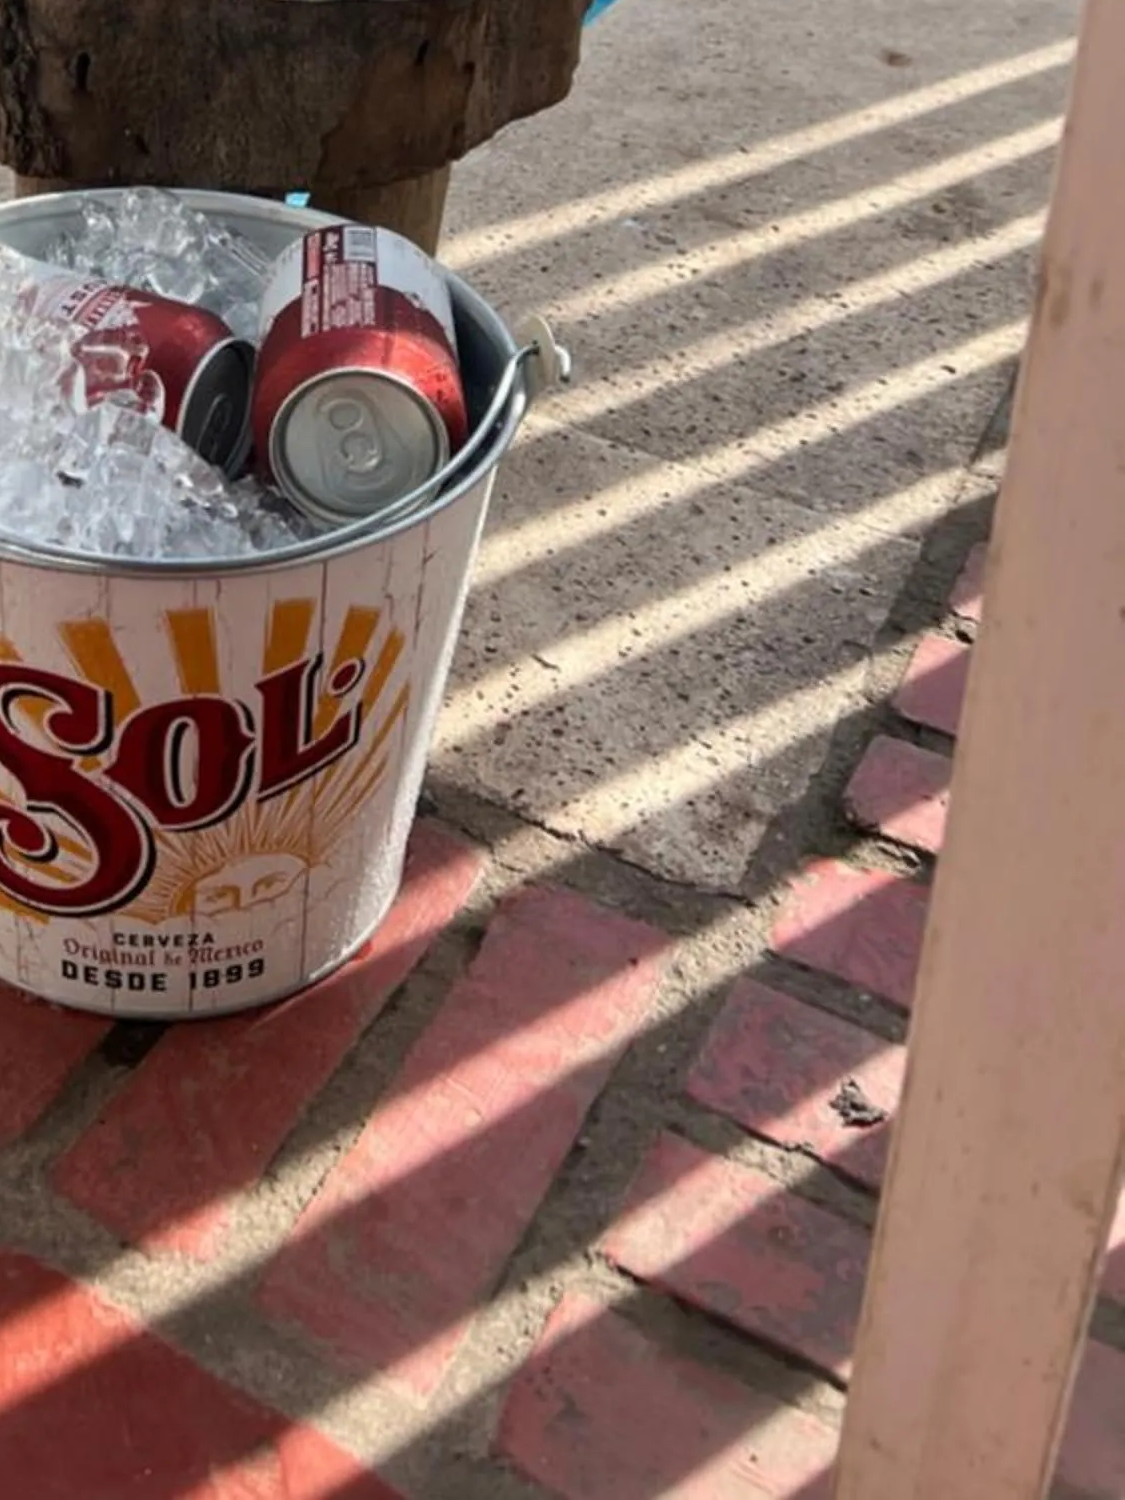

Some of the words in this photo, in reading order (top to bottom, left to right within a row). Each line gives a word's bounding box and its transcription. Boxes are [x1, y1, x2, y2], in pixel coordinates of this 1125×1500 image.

[63, 937, 155, 966] Original
[113, 932, 216, 948] CERVEZA
[61, 959, 168, 992] DESDE
[188, 957, 265, 991] 1899
